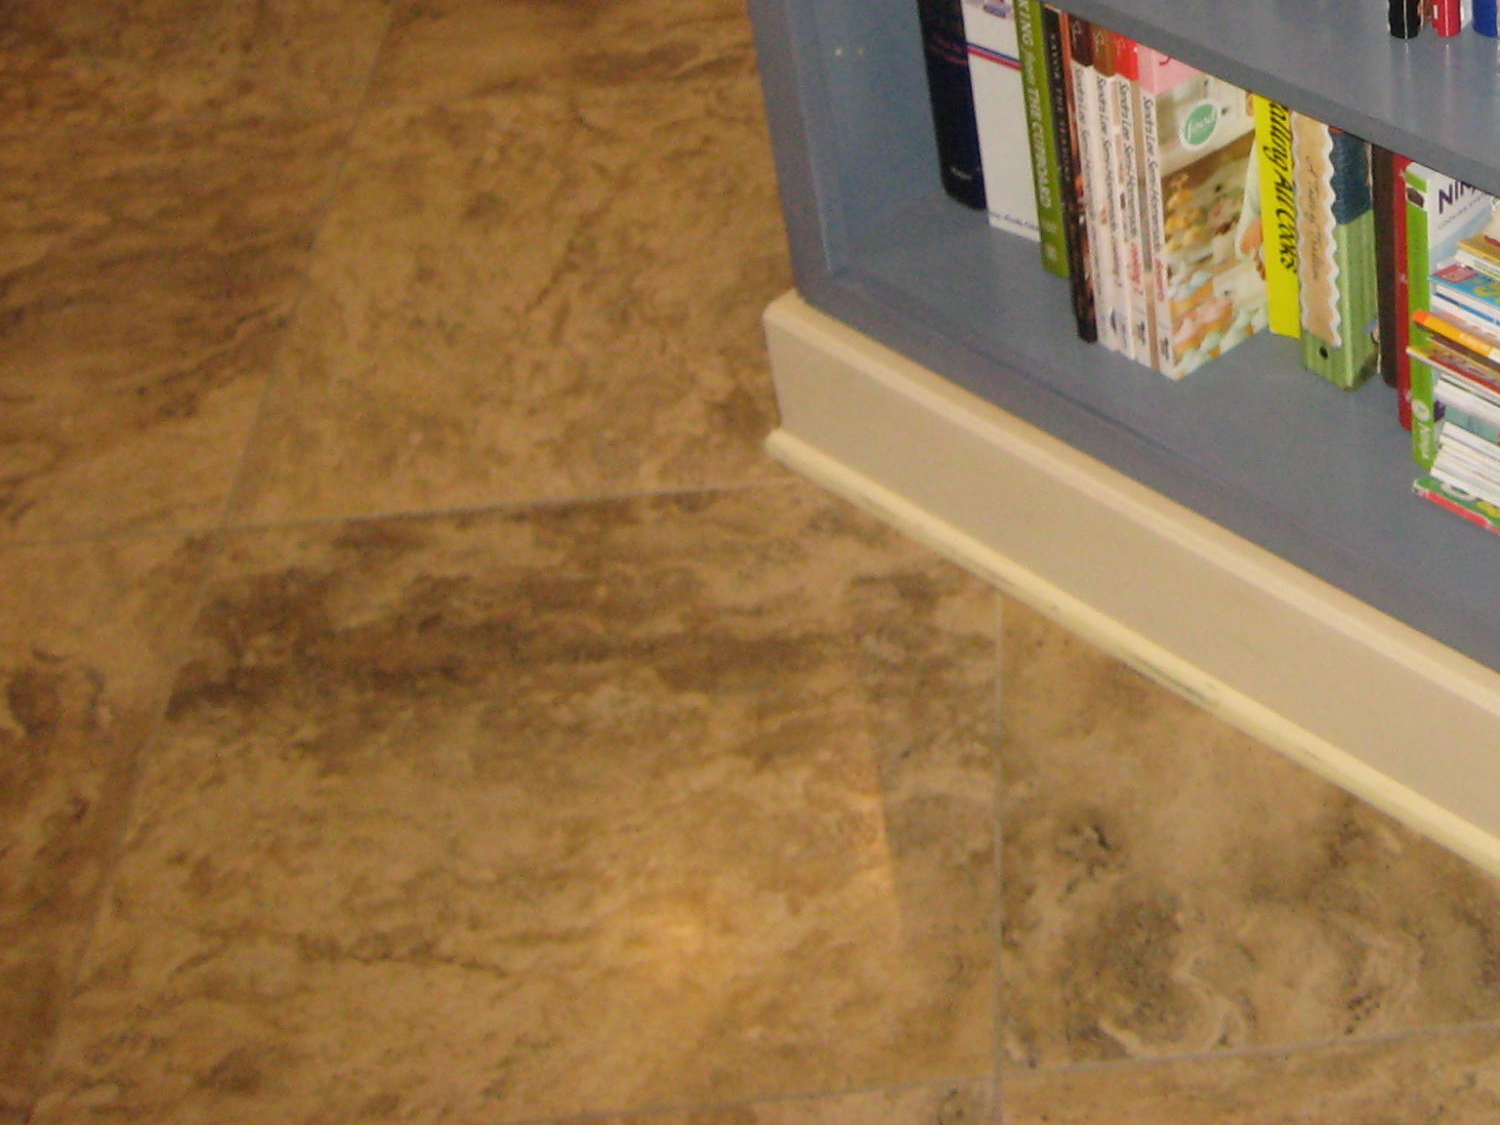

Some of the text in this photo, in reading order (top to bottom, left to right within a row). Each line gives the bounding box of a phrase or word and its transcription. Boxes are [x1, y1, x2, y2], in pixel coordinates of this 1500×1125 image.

[1027, 87, 1040, 119] THE
[1097, 77, 1111, 112] Sandra
[1119, 82, 1134, 118] Sandra
[1122, 120, 1134, 141] Lee
[1143, 96, 1156, 133] Sandra
[1145, 135, 1157, 156] Lee
[1030, 121, 1051, 209] CUPBOARD
